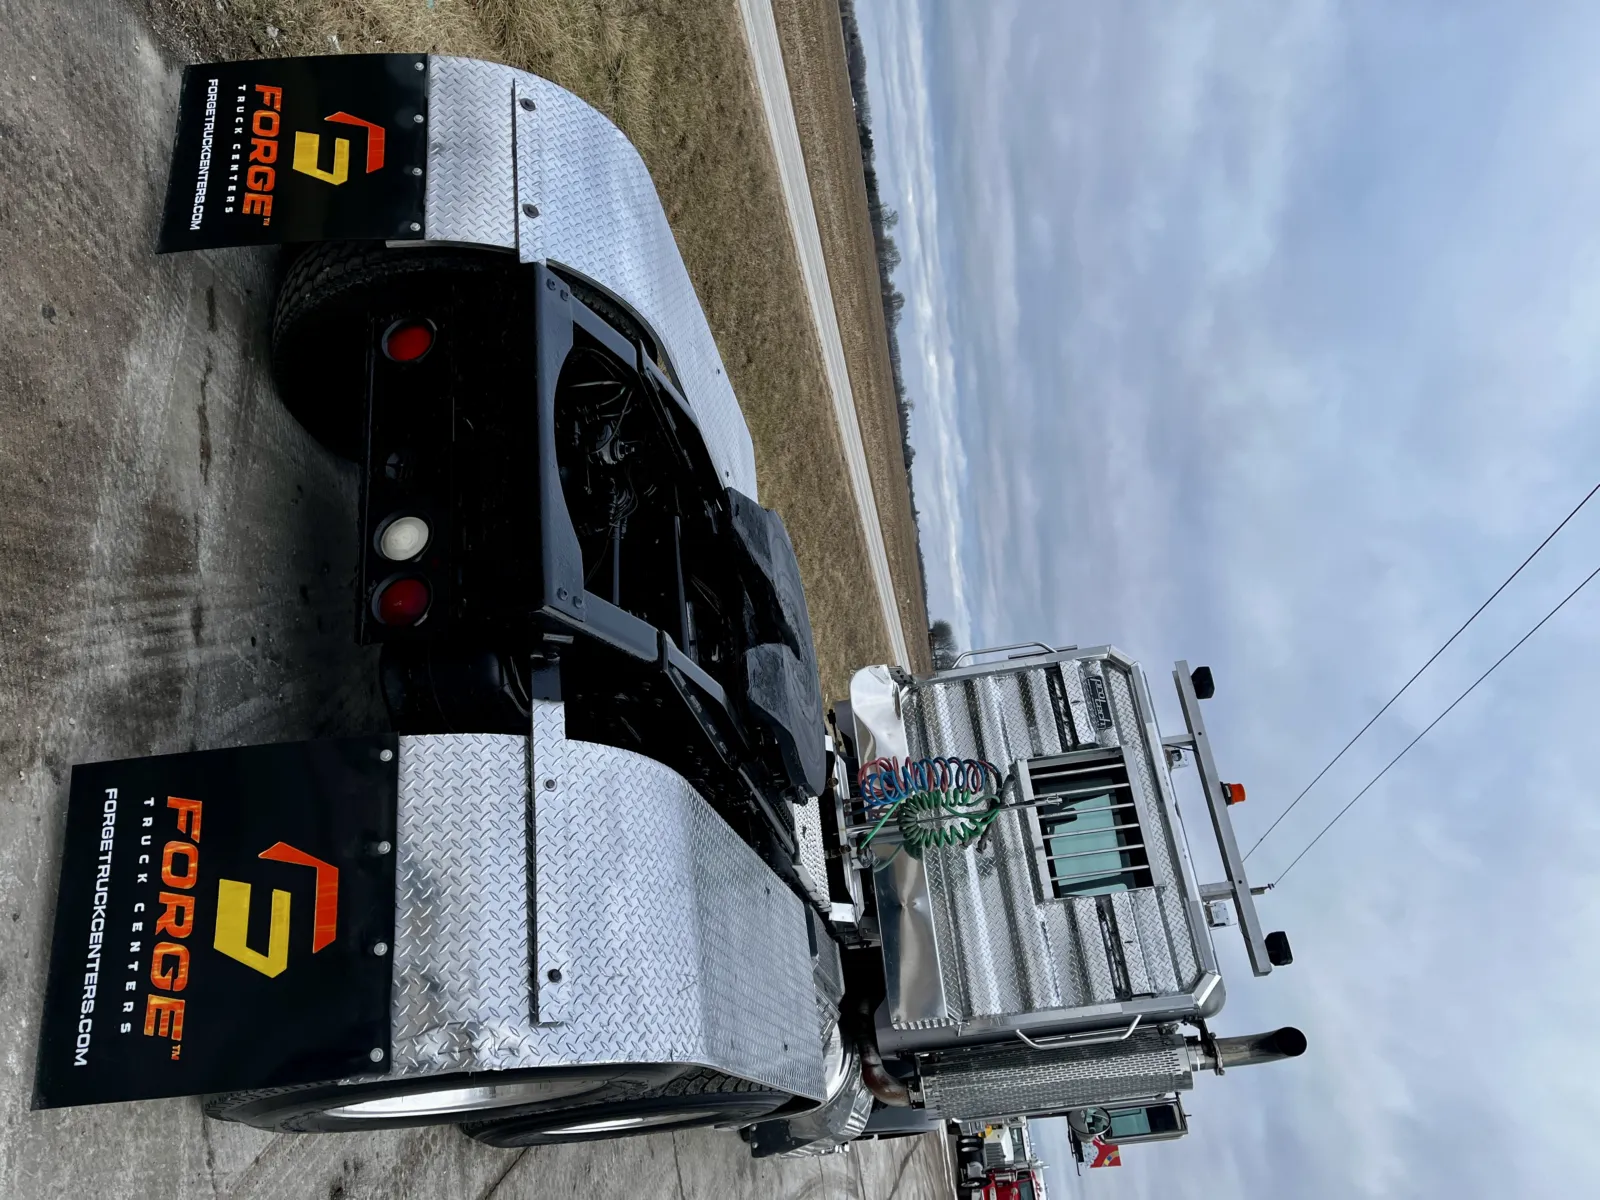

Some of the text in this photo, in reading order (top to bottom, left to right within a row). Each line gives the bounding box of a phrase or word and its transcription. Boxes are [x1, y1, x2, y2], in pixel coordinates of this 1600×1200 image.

[189, 78, 219, 231] FORGETRUCKCENTERS.COM
[224, 84, 247, 214] TRUCK CENTERS
[242, 84, 283, 216] FORGE
[73, 787, 118, 1067] FORGETRUCKCENTERS.COM
[120, 796, 155, 1034] TRUCK CENTERS
[143, 796, 203, 1041] FORGE
